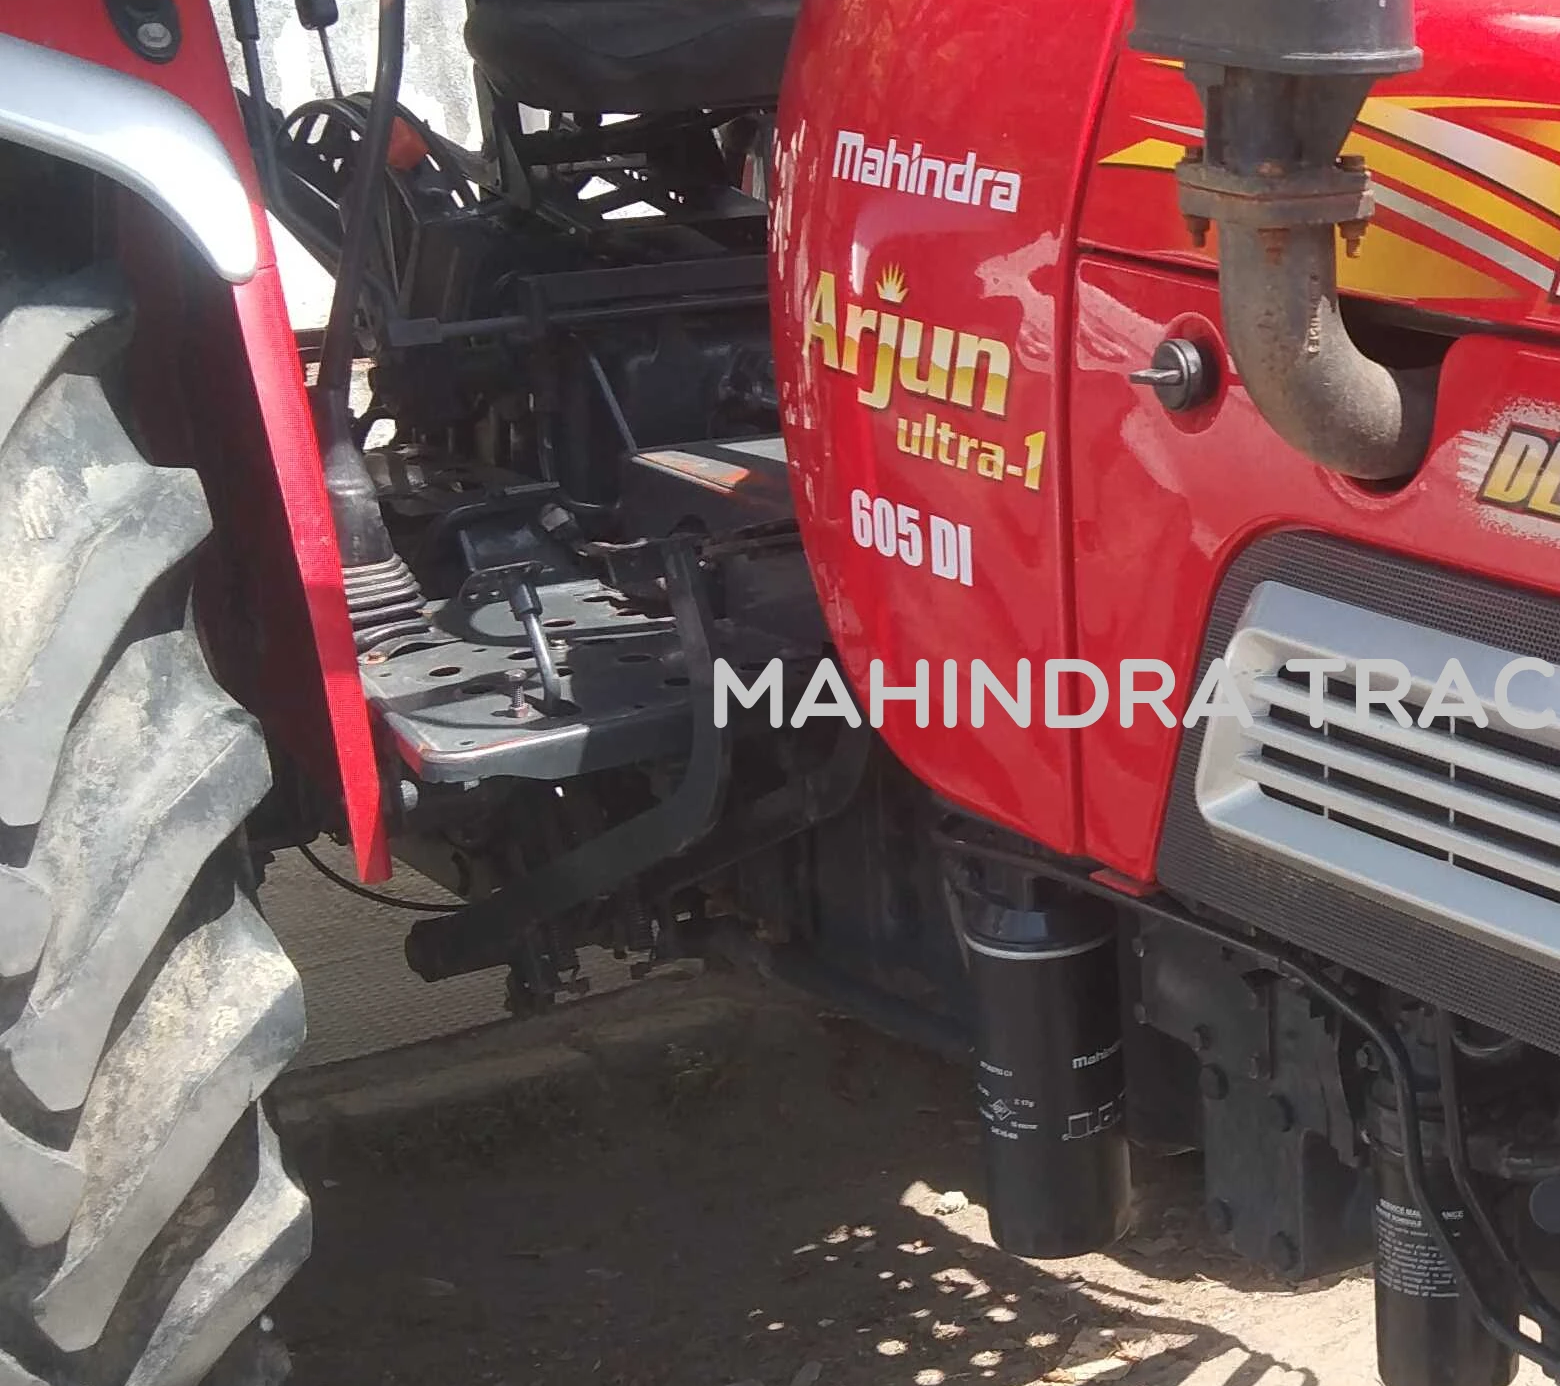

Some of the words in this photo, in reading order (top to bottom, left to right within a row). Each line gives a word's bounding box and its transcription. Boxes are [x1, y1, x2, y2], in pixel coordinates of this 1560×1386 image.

[832, 130, 1020, 213] Mahindra
[802, 265, 1013, 416] Arjun
[897, 414, 1046, 491] ultra-1
[850, 488, 923, 567] 605
[931, 514, 973, 586] DI
